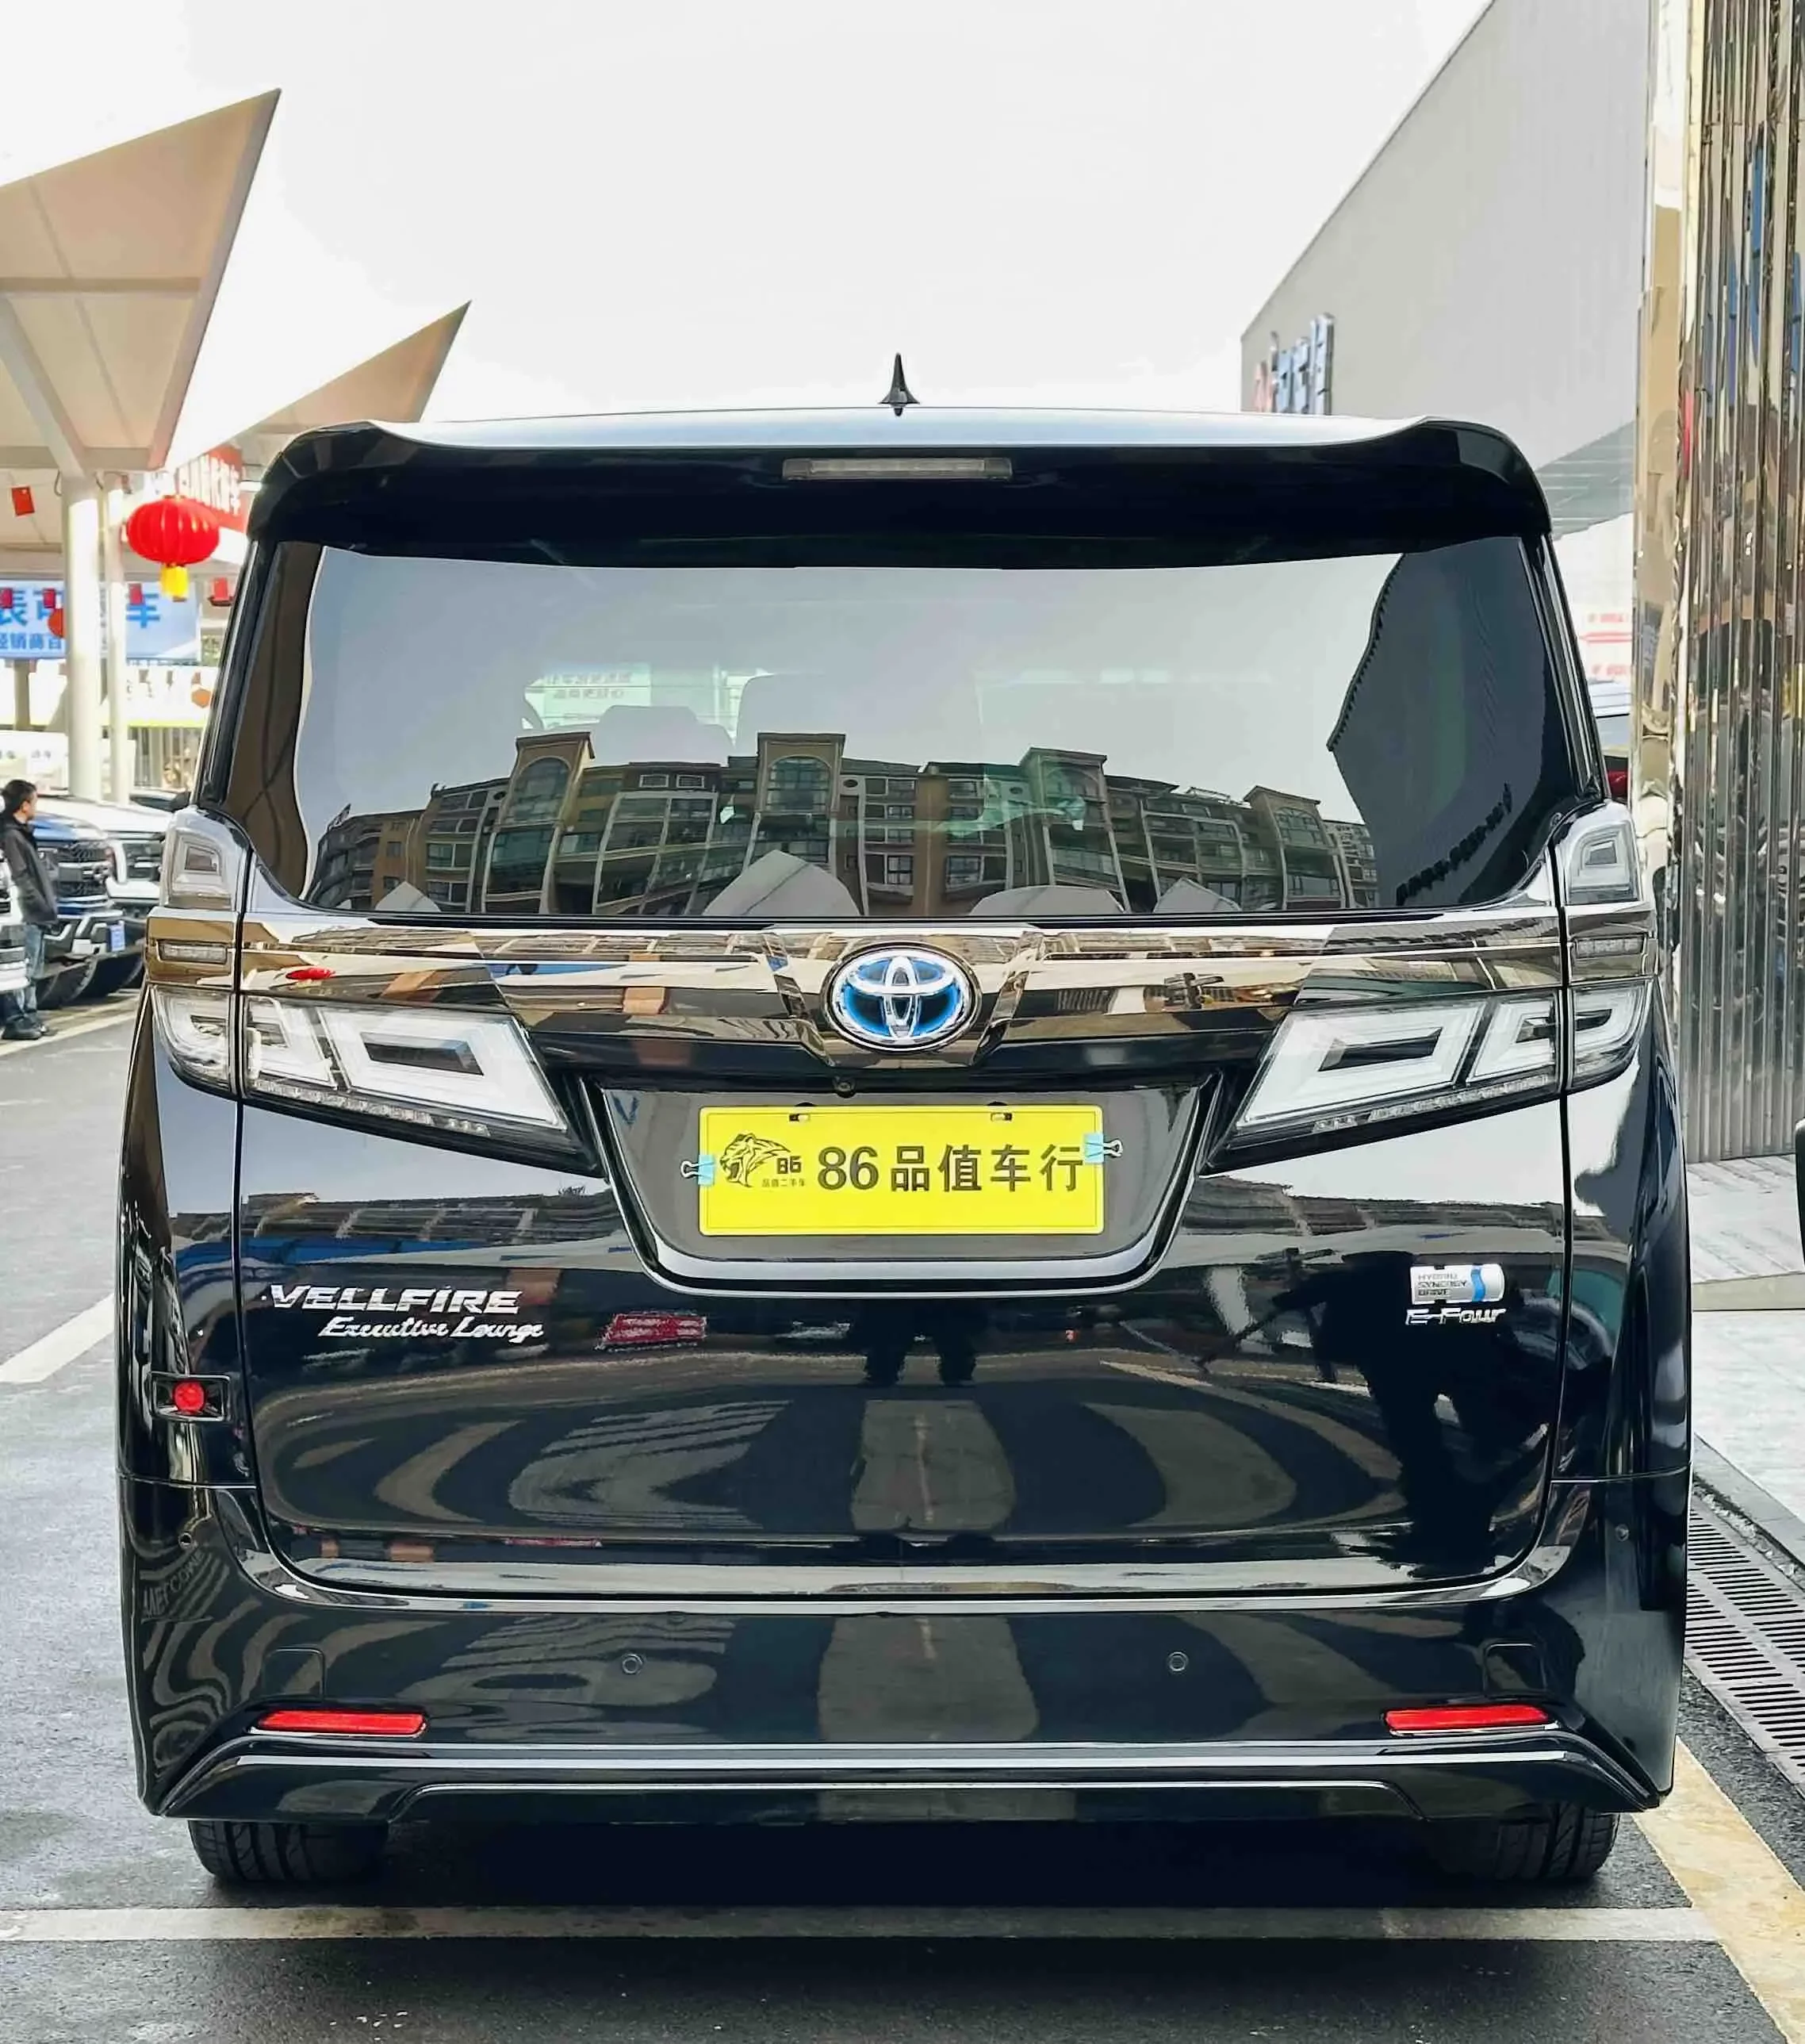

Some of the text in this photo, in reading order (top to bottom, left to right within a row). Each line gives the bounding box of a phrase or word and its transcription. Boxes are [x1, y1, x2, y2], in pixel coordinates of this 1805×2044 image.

[777, 1155, 802, 1175] 86
[818, 1144, 1084, 1192] 86品值车行
[270, 1284, 523, 1314] VELLFIRE
[318, 1316, 544, 1343] Executive Lounge
[1405, 1308, 1507, 1325] E-Four
